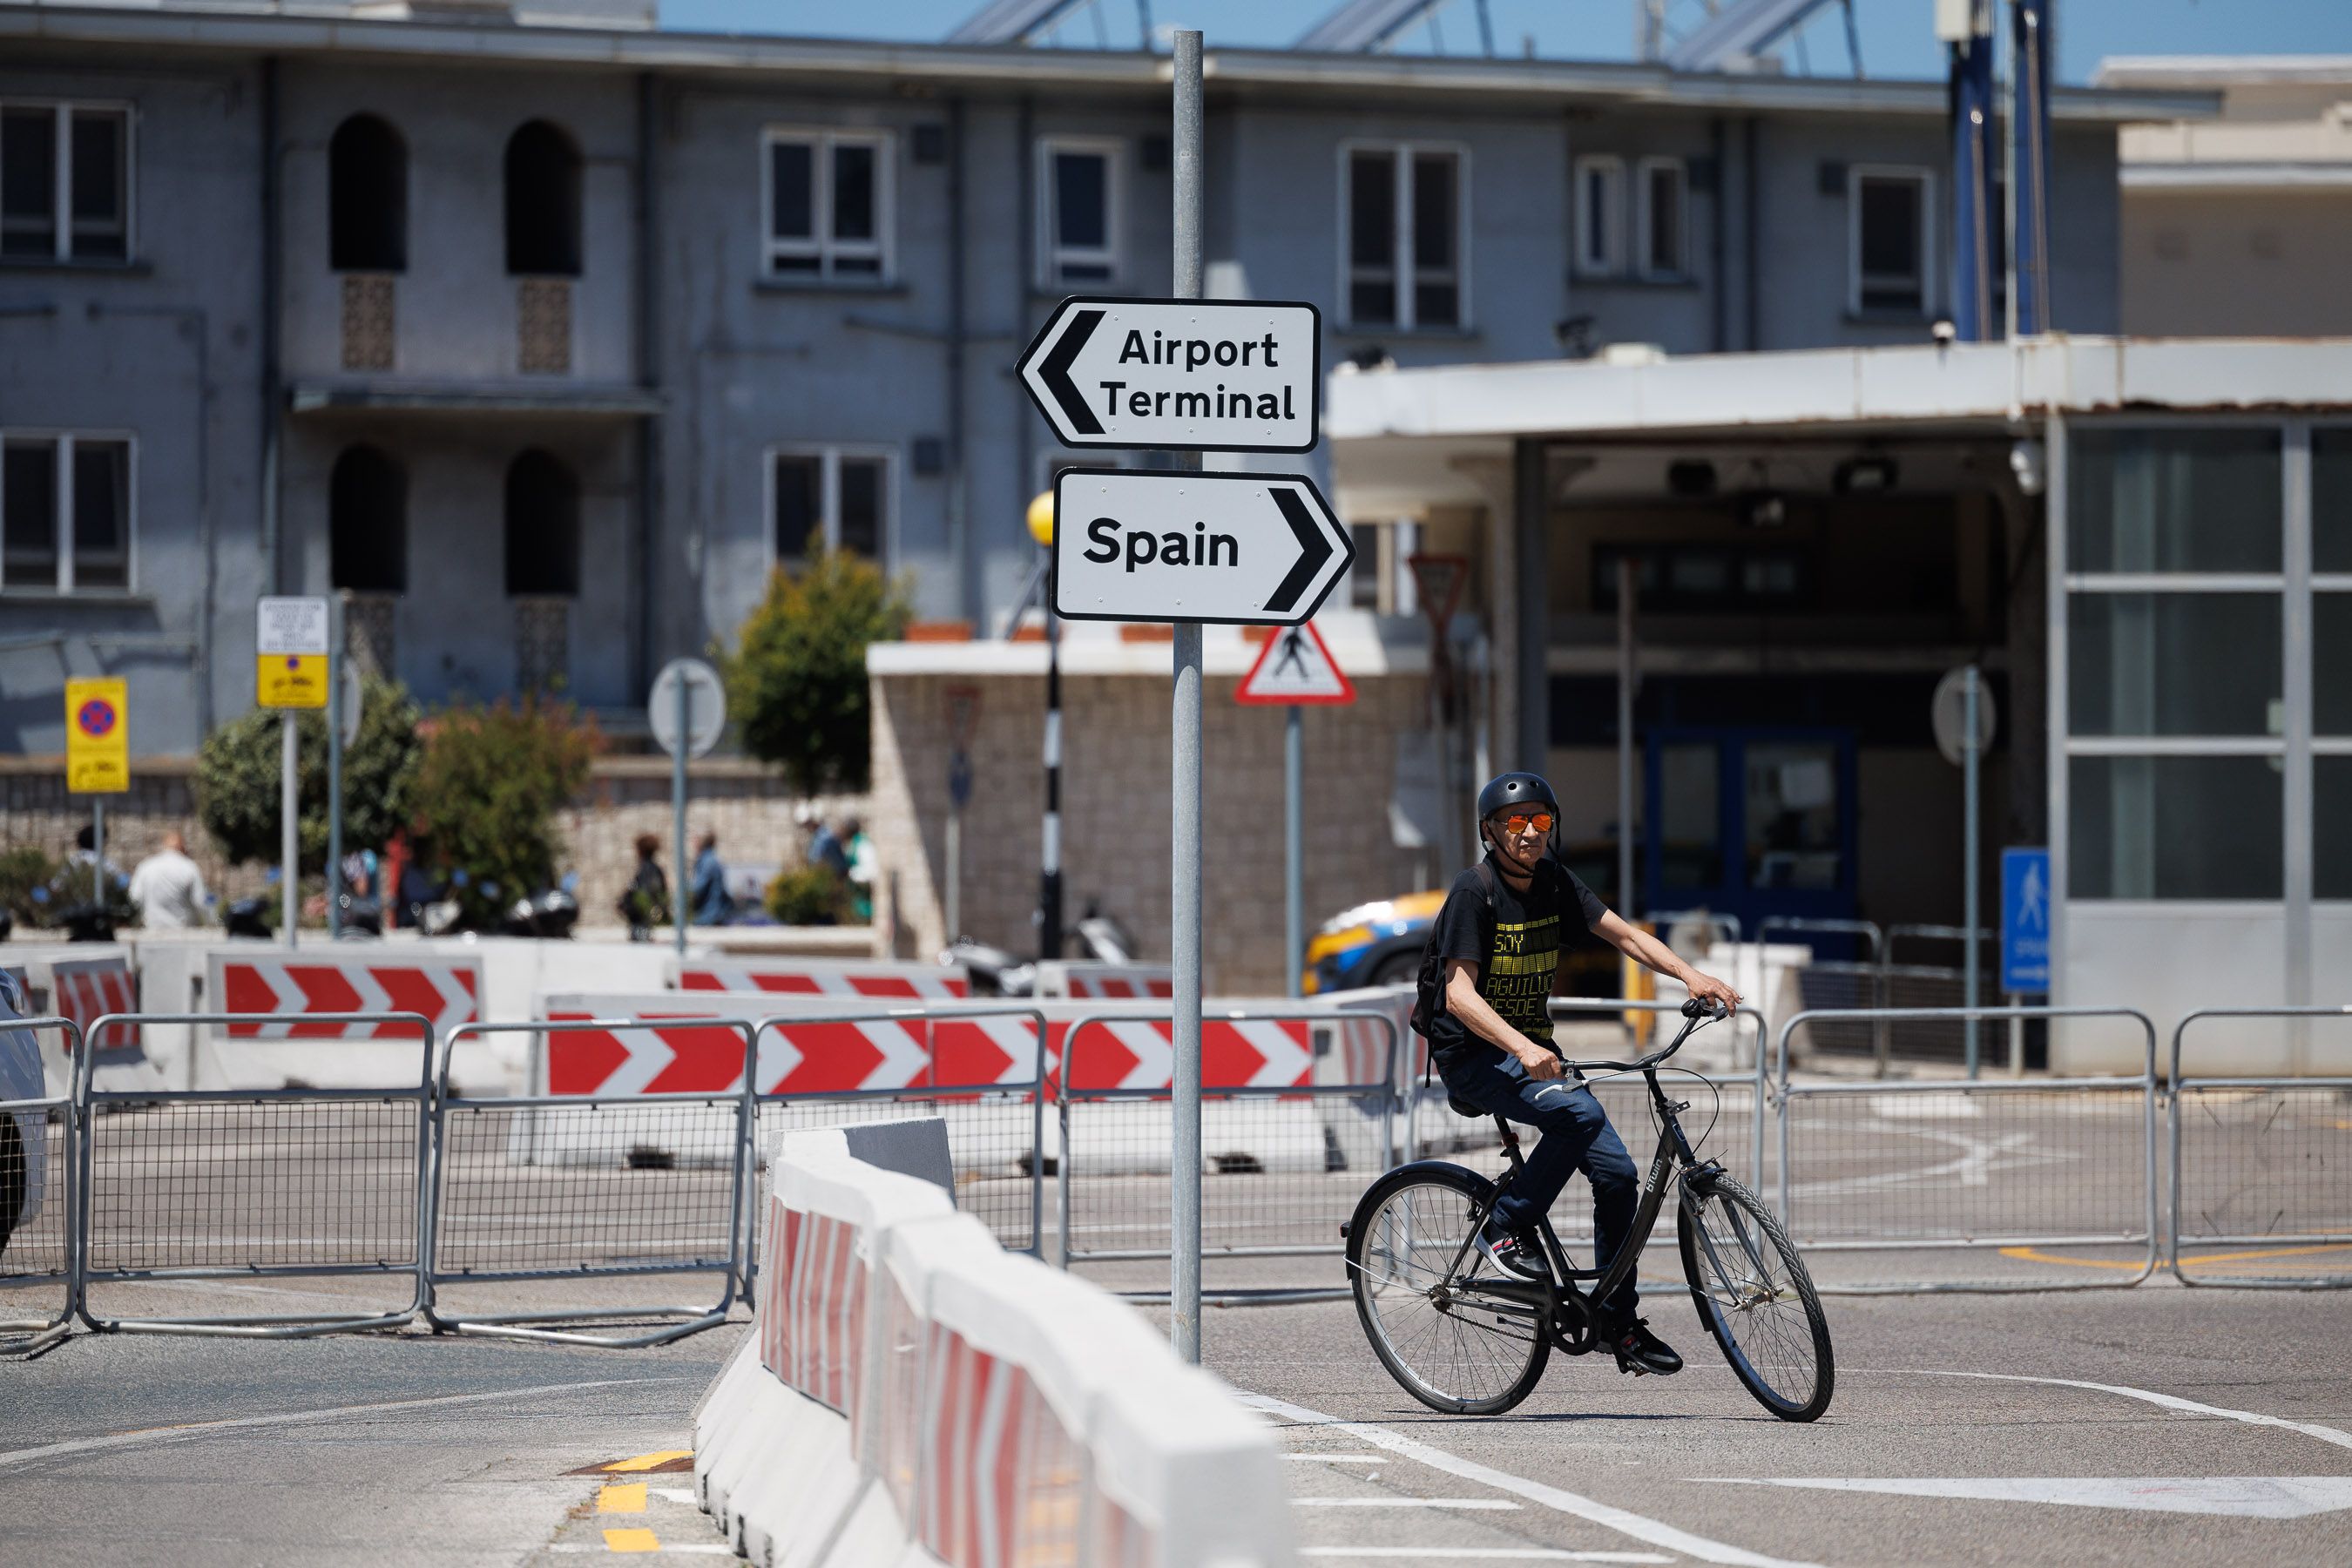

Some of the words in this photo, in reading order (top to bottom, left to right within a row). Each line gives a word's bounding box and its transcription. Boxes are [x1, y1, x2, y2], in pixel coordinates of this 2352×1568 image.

[1118, 329, 1279, 372] Airport
[1099, 382, 1295, 420] Terminal
[1083, 517, 1239, 572] Spain
[1494, 934, 1524, 953] SOY
